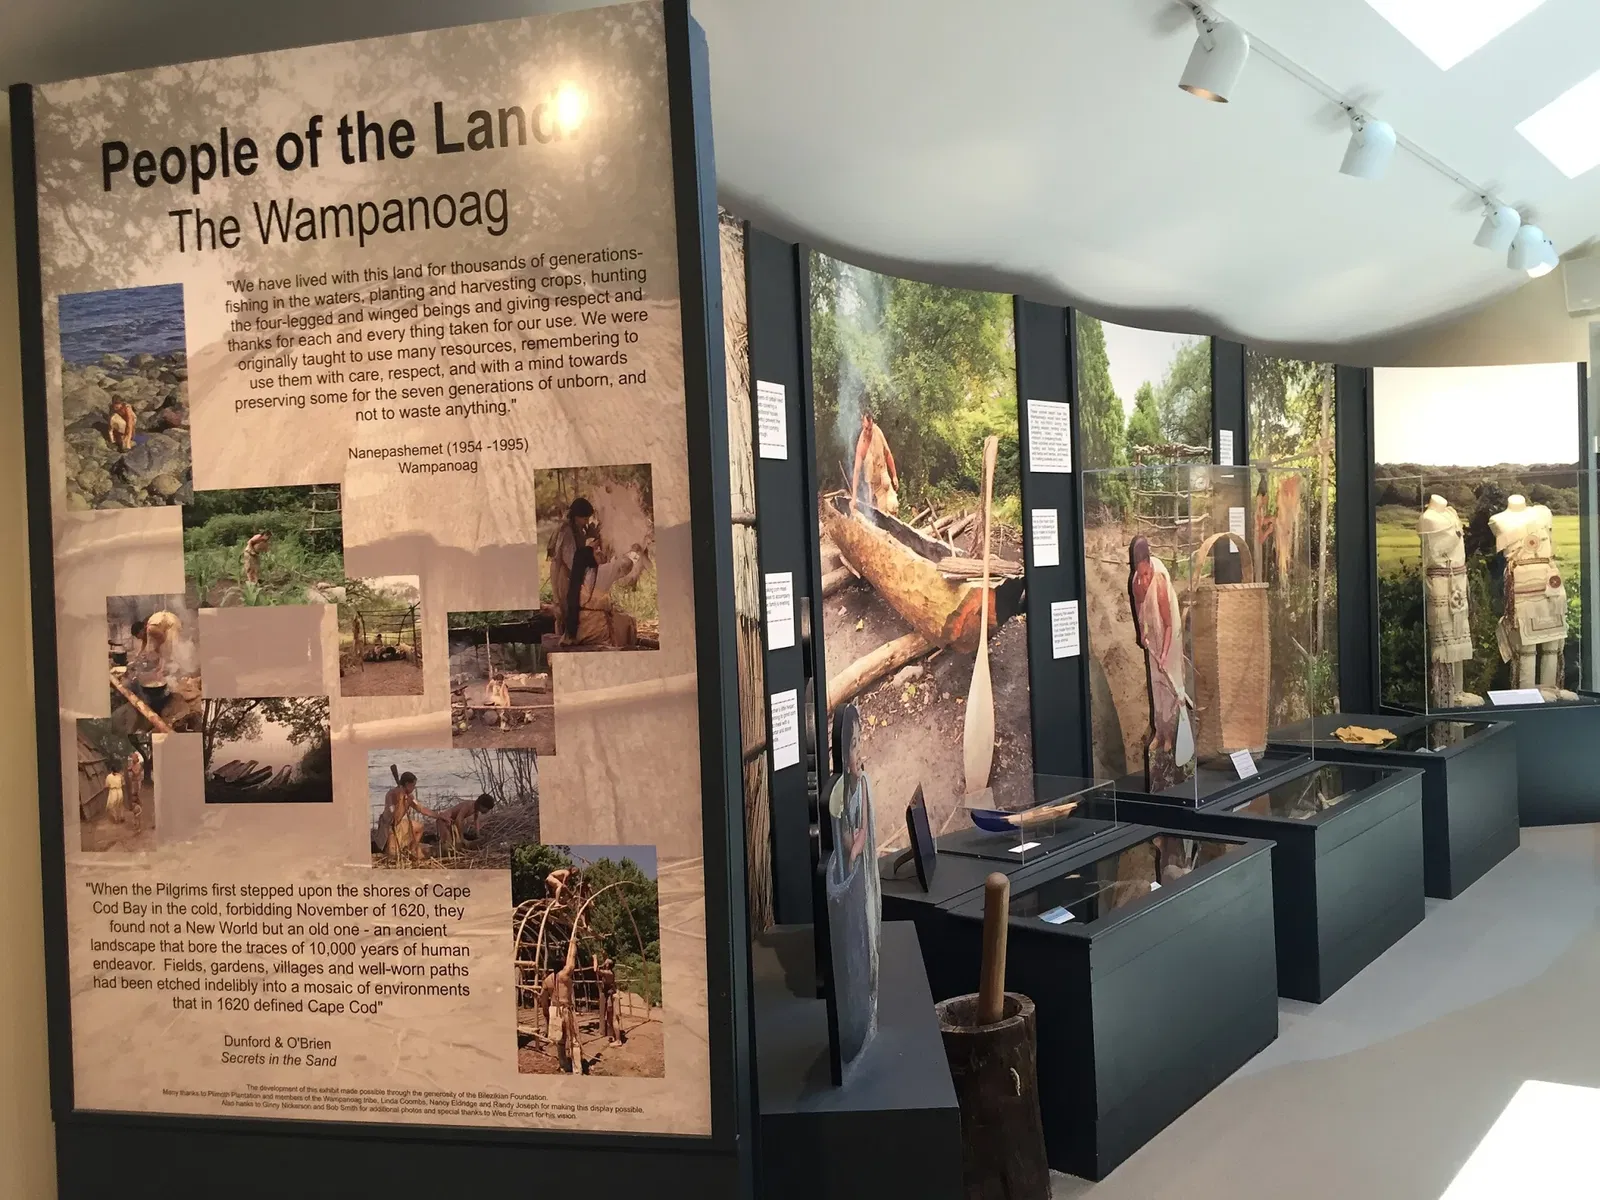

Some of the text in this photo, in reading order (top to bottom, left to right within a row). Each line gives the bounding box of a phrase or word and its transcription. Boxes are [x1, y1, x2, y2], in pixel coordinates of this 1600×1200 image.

[102, 127, 258, 194] People
[276, 115, 323, 171] of
[337, 110, 416, 164] the
[168, 188, 508, 252] The Wampanoag
[226, 247, 643, 293] "We have lived with this land for thousands of generations-
[225, 267, 646, 314] fishing in the waters, planting and harvesting crops, hunting
[230, 286, 643, 332] the four-legged and winged beings and giving respect and
[227, 310, 648, 352] thanks for each and every thing taken for our use. We were
[237, 330, 638, 372] originally taught to use many resources, remembering to
[249, 350, 627, 389] use them with care, respect, and with a mind towards
[355, 398, 516, 421] not to waste anything."
[348, 437, 528, 460] Nanepashemet (1954 -1995)
[398, 460, 478, 475] Wampanoag
[86, 882, 470, 900] "When the Pilgrims first stepped upon the shores of Cape
[92, 900, 464, 920] Cod Bay in the cold, forbidding November of 1620, they
[109, 919, 145, 933] found
[149, 921, 169, 933] not
[173, 923, 181, 933] a
[186, 920, 215, 934] New
[218, 921, 258, 934] World
[262, 921, 283, 935] but
[287, 924, 304, 935] an
[308, 922, 329, 935] old
[333, 925, 359, 936] one
[373, 925, 391, 936] an
[395, 922, 448, 937] ancient
[90, 938, 469, 959] landscape that bore the traces of 10,000 years of human
[93, 975, 470, 996] had been etched indelibly into a mosaic of environments
[172, 996, 383, 1016] that in 1620 defined Cape Cod"
[224, 1034, 331, 1049] Dunford & O'Brien
[221, 1051, 337, 1067] Secrets in the Sand
